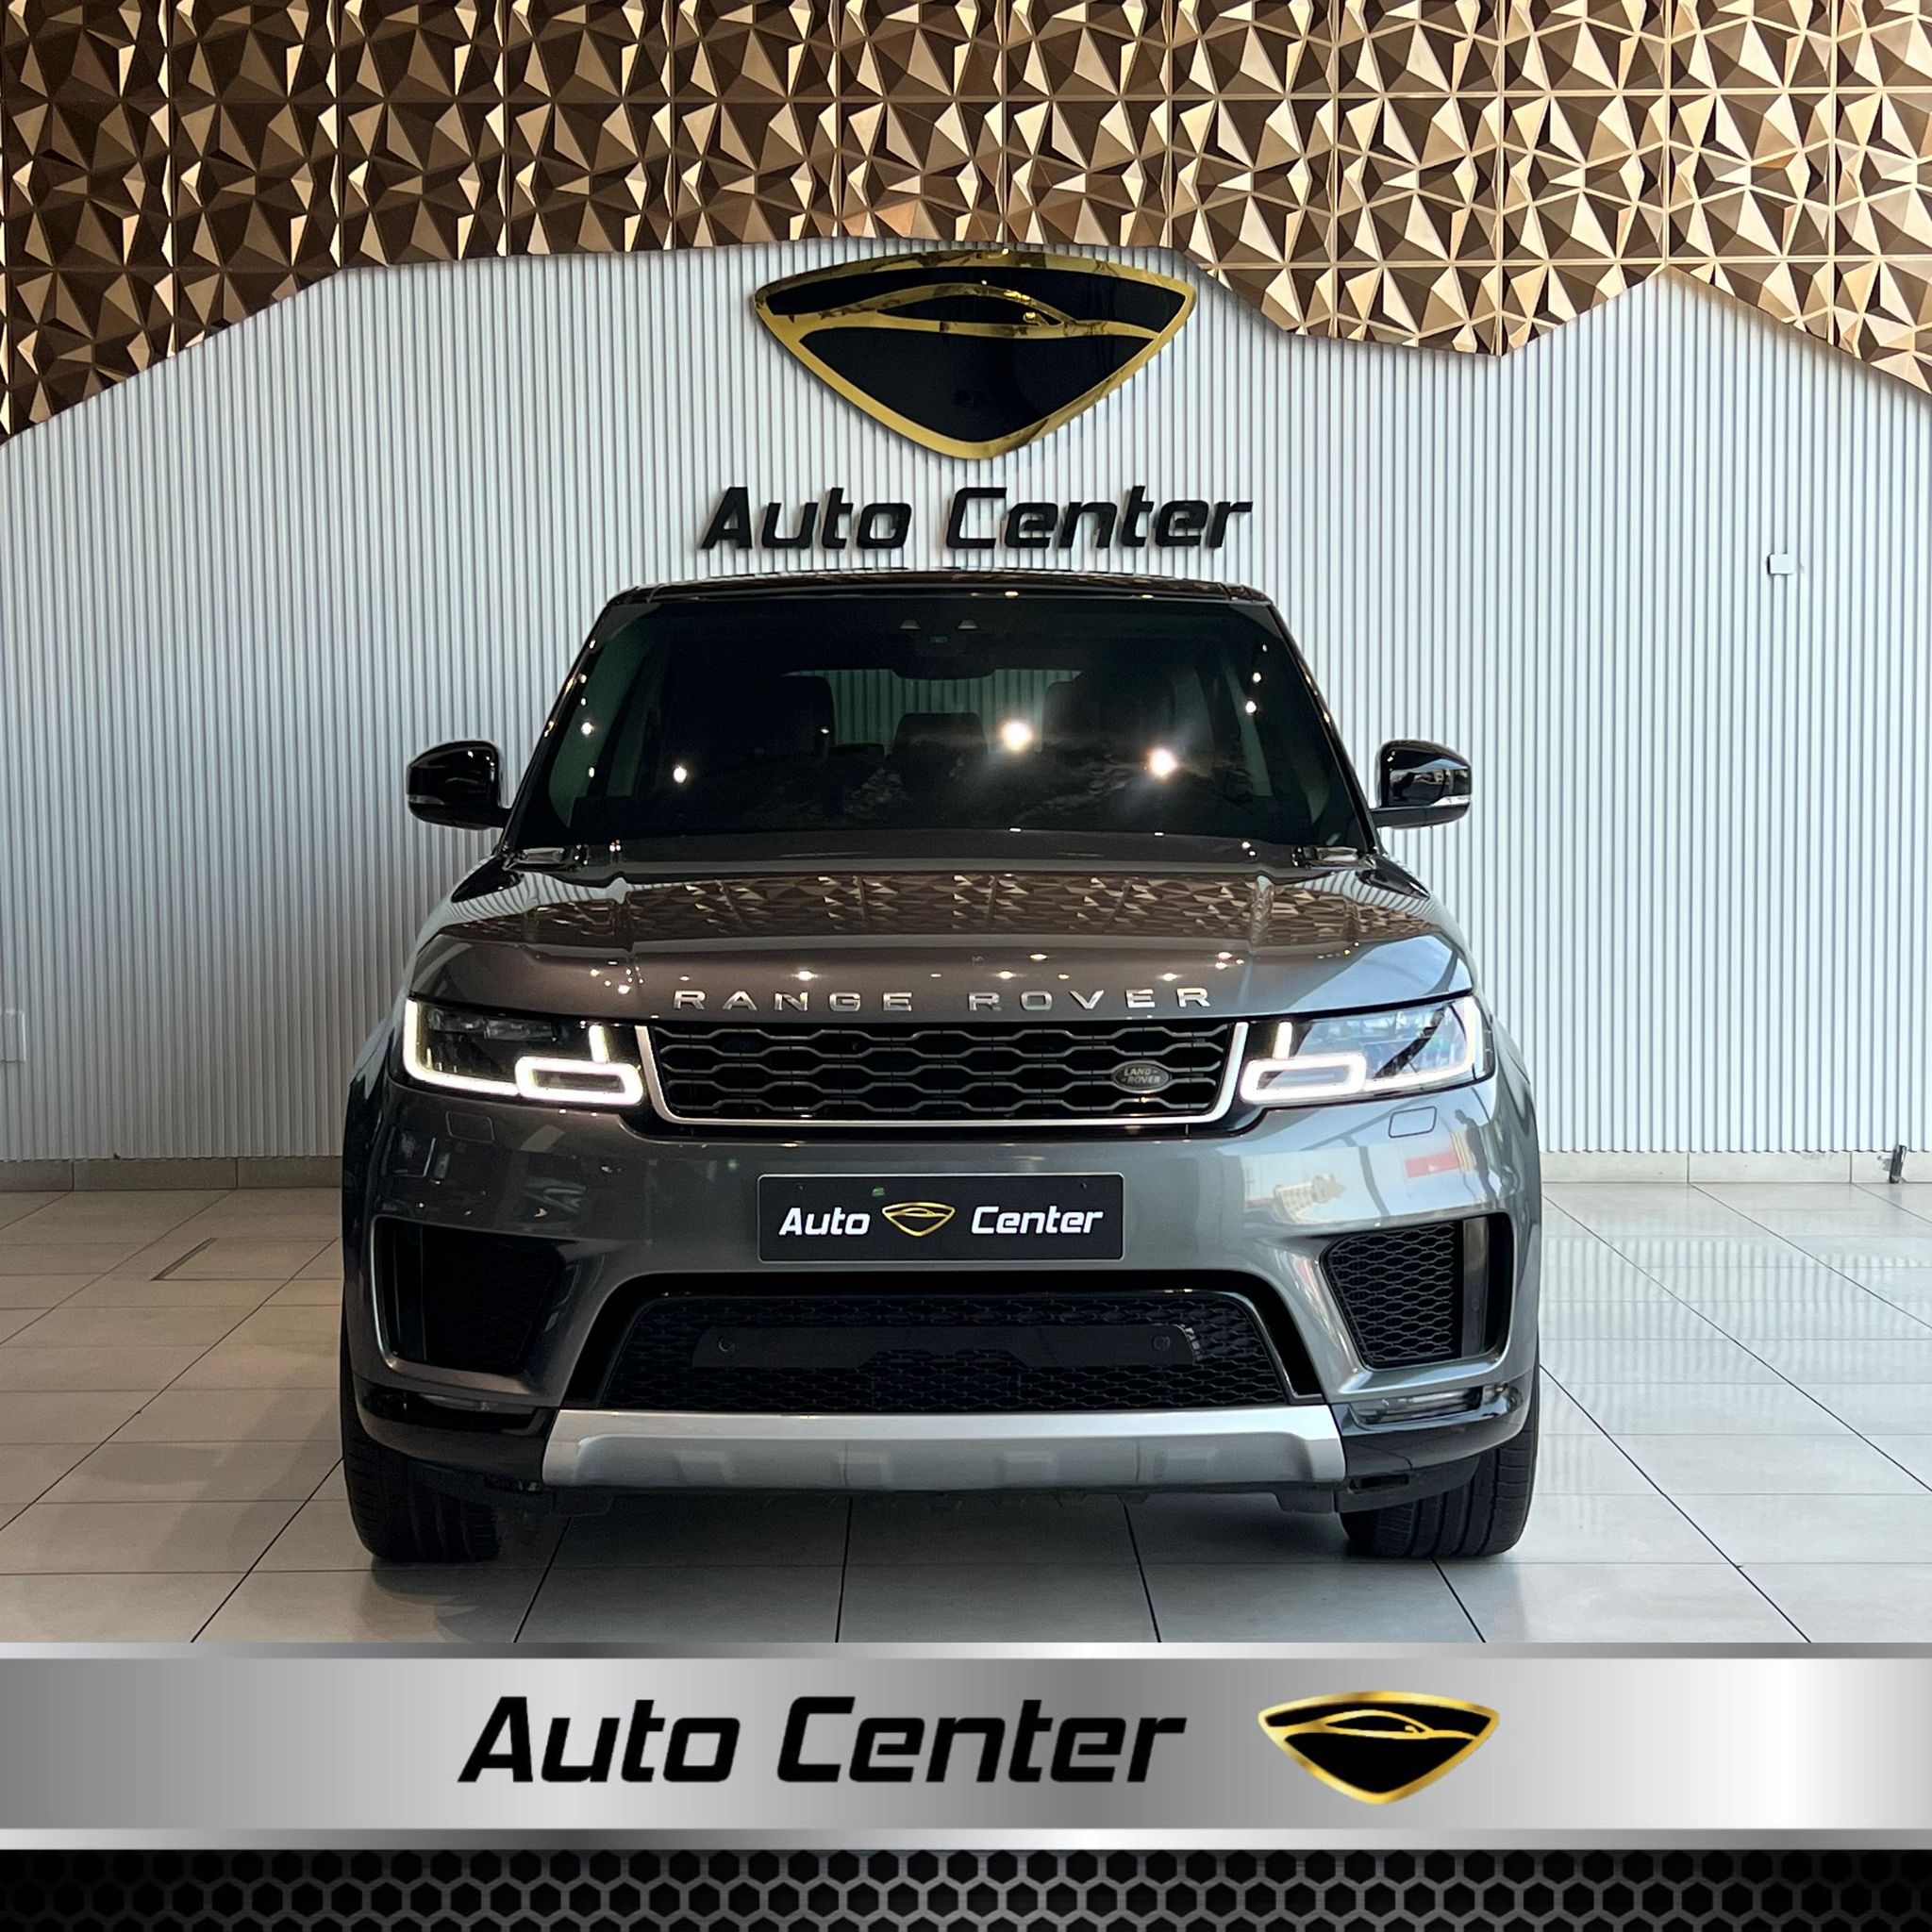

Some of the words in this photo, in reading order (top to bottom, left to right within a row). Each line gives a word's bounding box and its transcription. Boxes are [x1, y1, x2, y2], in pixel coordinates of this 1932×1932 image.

[701, 486, 912, 551] Auto
[945, 485, 1254, 550] Center
[673, 990, 913, 1012] RANGE
[968, 987, 1213, 1012] ROVER
[1127, 1075, 1161, 1084] ROVER
[778, 1207, 871, 1236] Auto
[971, 1206, 1104, 1235] Center
